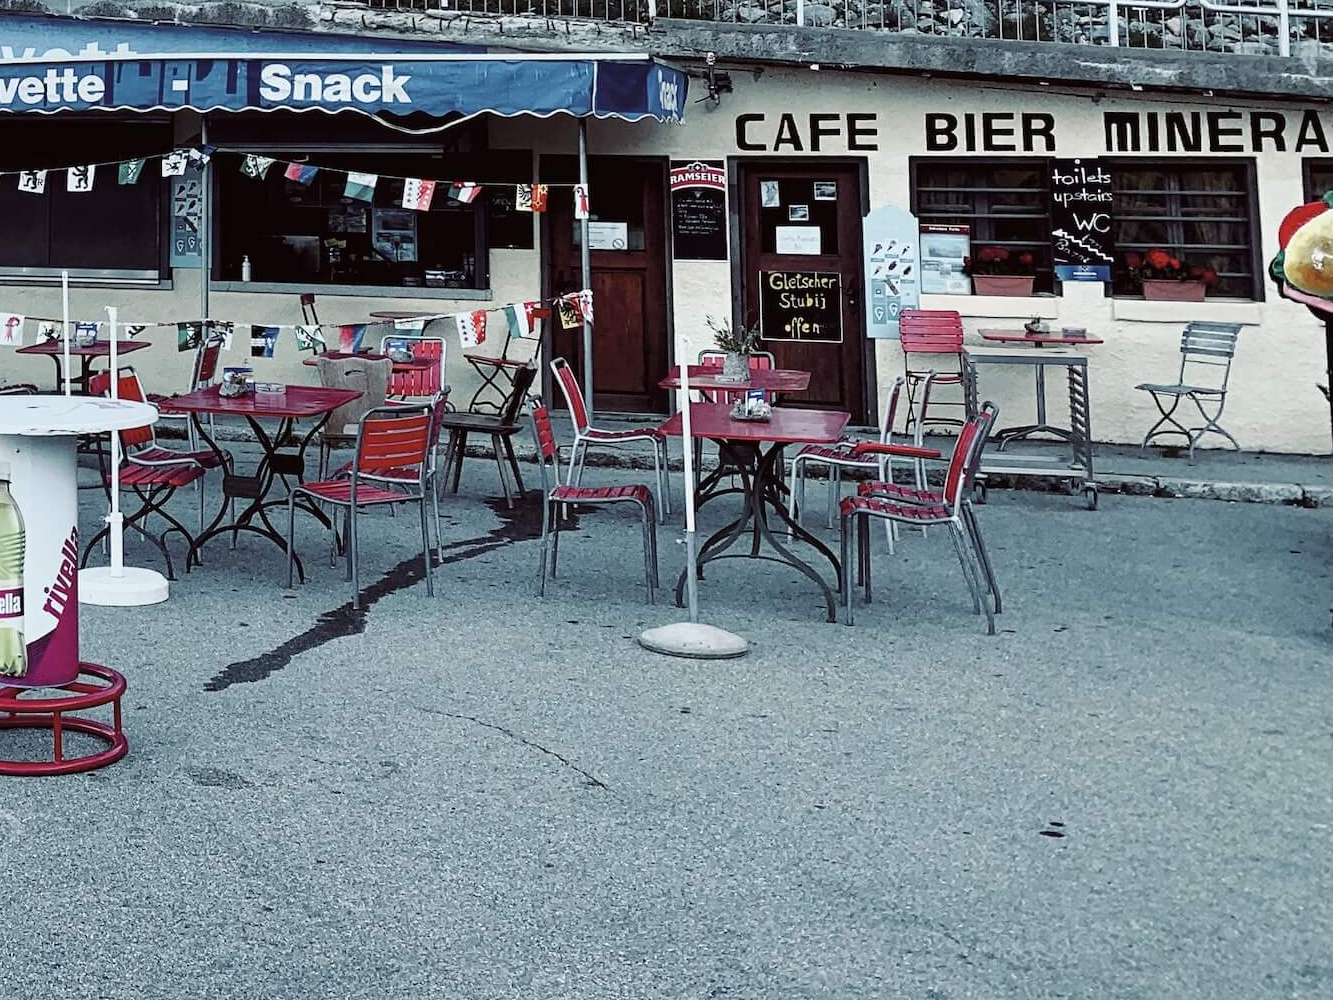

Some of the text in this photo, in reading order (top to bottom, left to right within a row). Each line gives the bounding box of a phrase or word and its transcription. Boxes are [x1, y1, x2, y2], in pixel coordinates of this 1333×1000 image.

[259, 63, 412, 104] Snack
[735, 112, 879, 152] CAFE
[924, 112, 1057, 152] BIER
[670, 172, 727, 185] RAMSEIER
[1052, 166, 1112, 185] toilets
[1053, 187, 1114, 209] upstairs
[1072, 212, 1111, 233] WC
[768, 271, 837, 291] Gletscher
[778, 292, 827, 310] Stubij
[784, 316, 821, 340] offen
